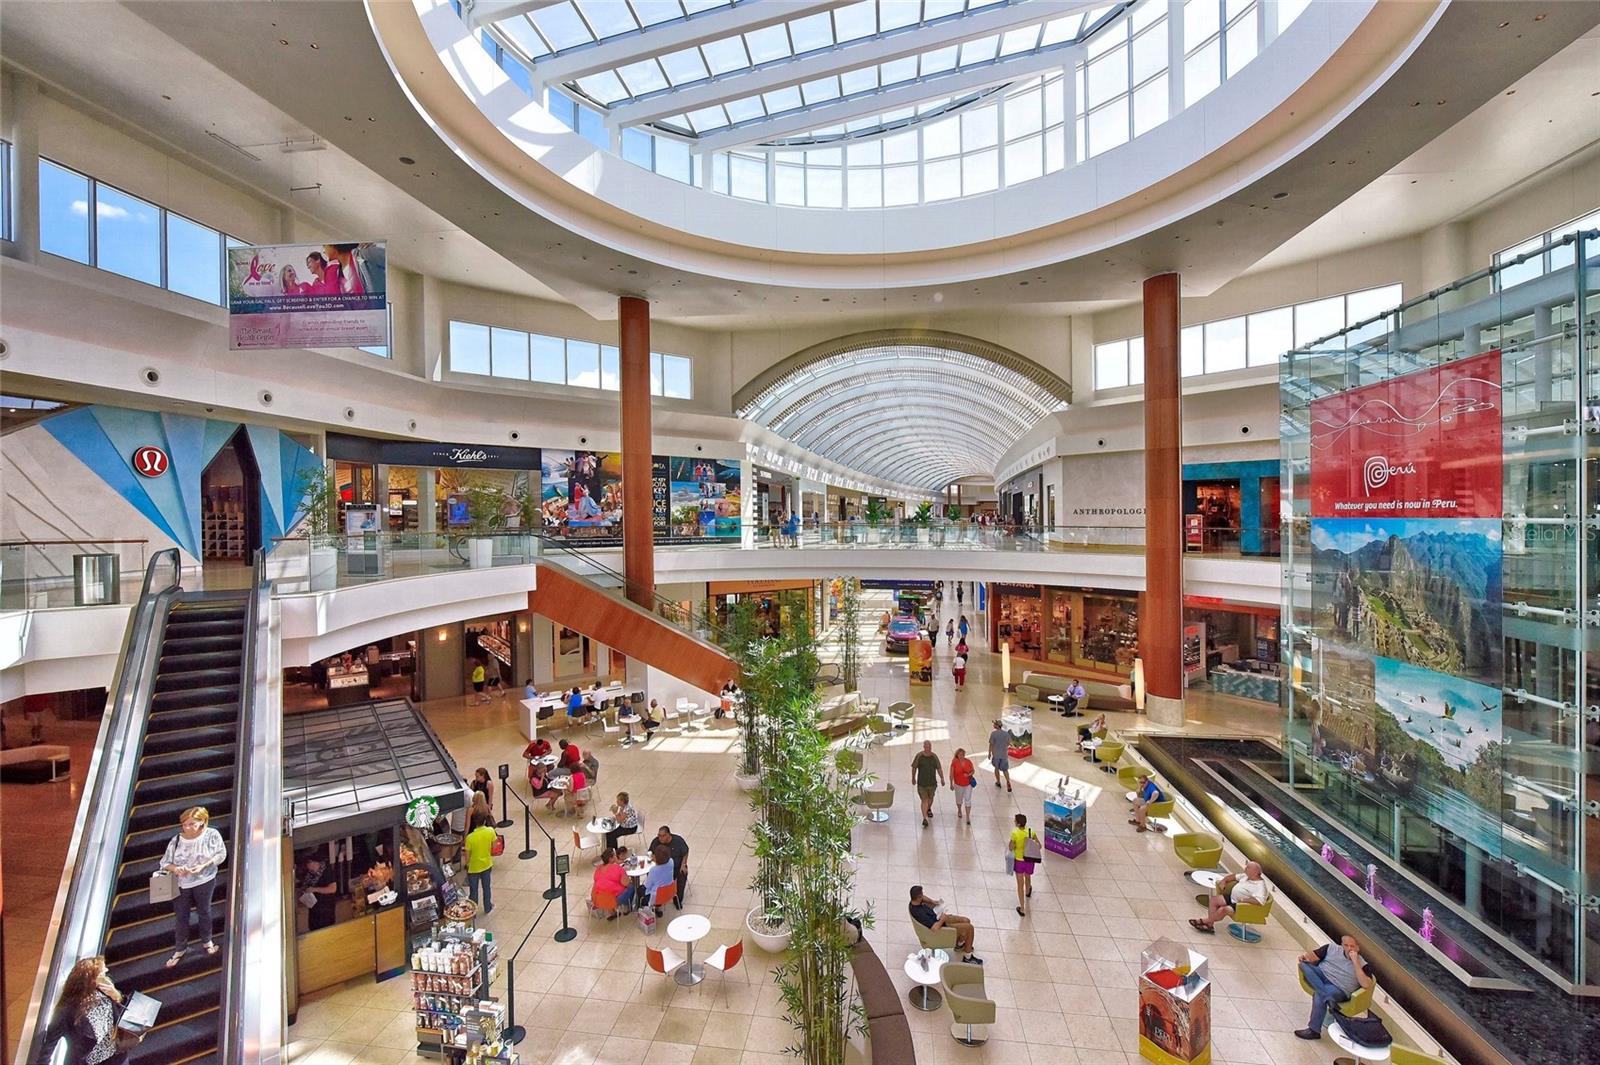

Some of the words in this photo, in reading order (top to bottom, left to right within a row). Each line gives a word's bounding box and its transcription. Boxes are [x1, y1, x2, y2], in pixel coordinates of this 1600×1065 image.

[449, 448, 487, 463] Kiehl's
[1364, 456, 1416, 497] Perú
[1072, 508, 1147, 516] ANTHROPOLOGI
[1334, 501, 1364, 510] Whatever
[1364, 502, 1378, 512] you
[1378, 500, 1396, 509] need
[1396, 499, 1403, 509] is
[1404, 501, 1421, 509] now
[1422, 498, 1431, 508] in
